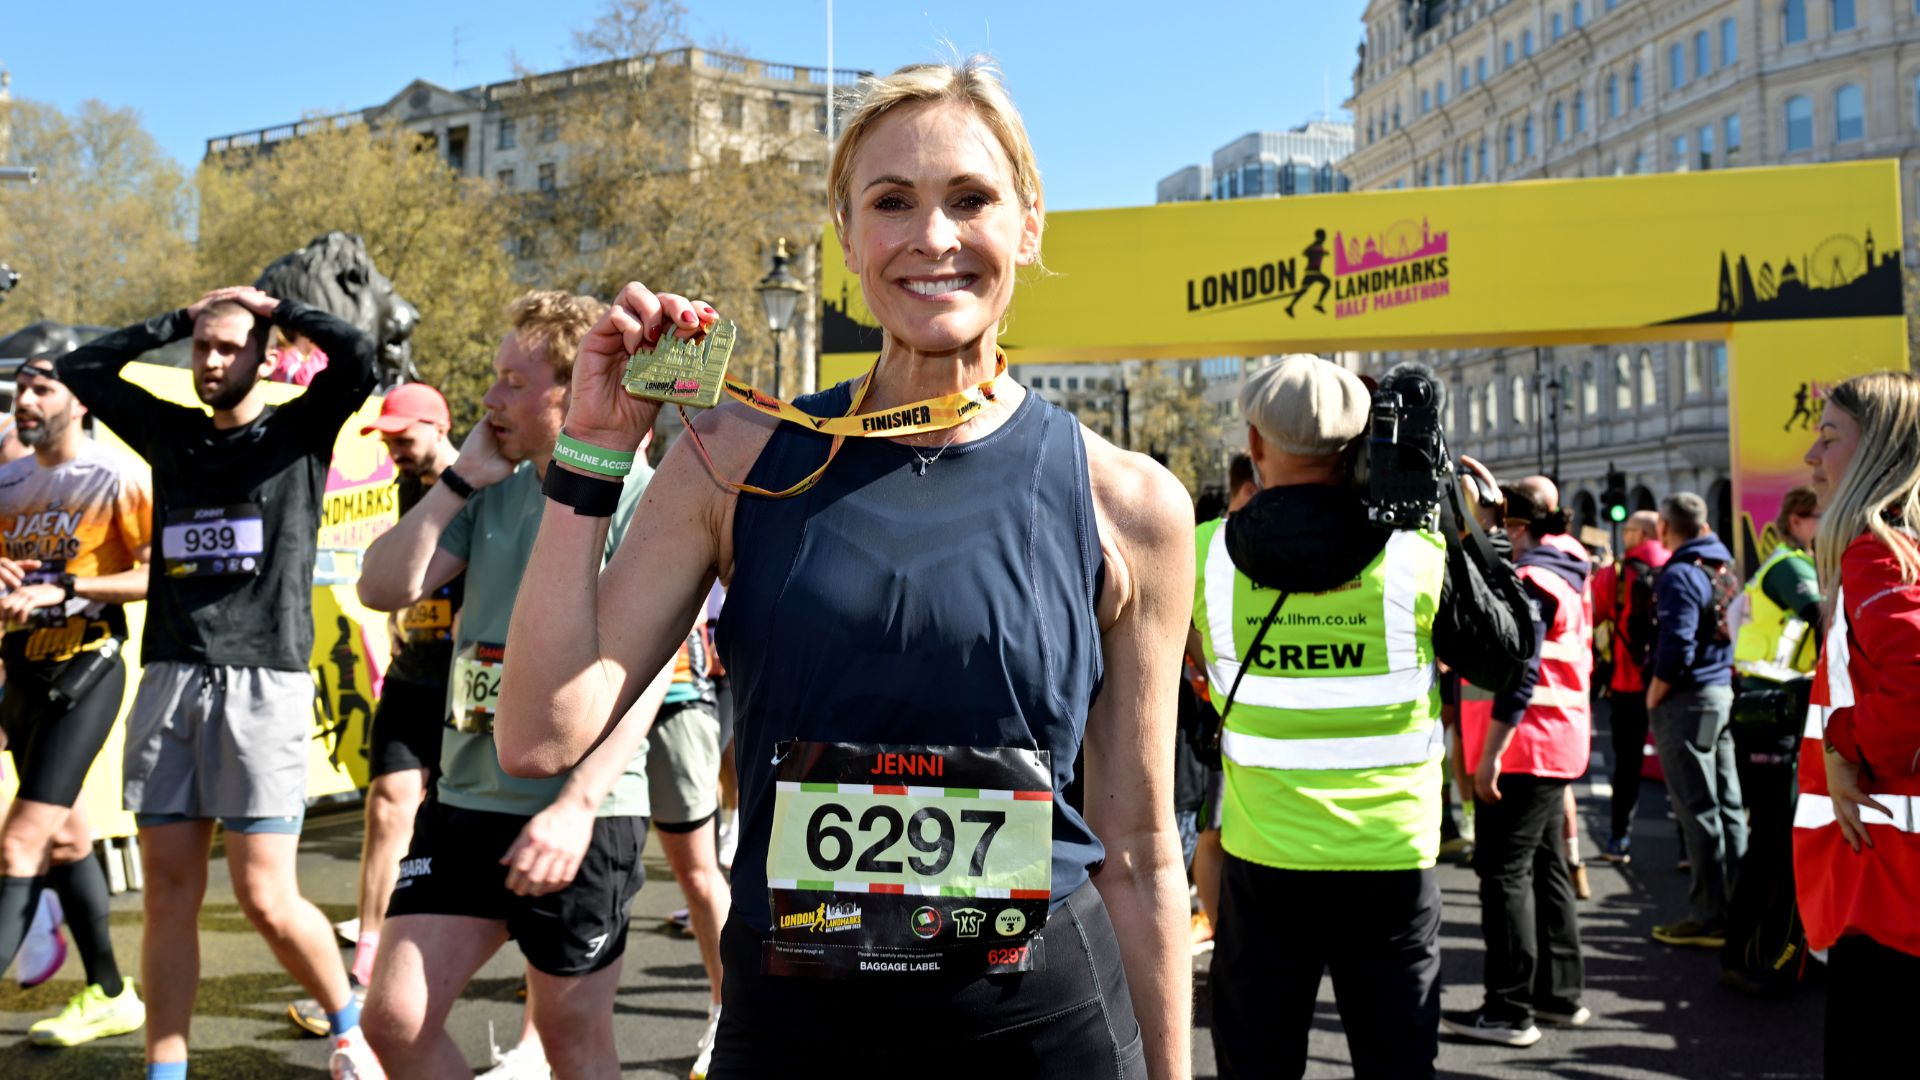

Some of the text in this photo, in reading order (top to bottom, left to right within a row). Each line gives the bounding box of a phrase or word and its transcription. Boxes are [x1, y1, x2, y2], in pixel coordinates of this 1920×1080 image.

[1187, 257, 1296, 312] LONDON
[1335, 256, 1449, 301] LANDMARKS
[1335, 279, 1450, 320] HALF MARATHON
[645, 382, 670, 391] LONDON
[862, 405, 931, 431] FINISHER
[184, 526, 235, 552] 939
[1254, 643, 1365, 670] CREW
[871, 752, 944, 777] JENNI
[806, 803, 1006, 877] 6297
[781, 911, 816, 929] LONDON
[826, 915, 861, 928] LANDMARKS
[960, 915, 977, 933] XS
[1005, 923, 1015, 932] 3
[860, 961, 941, 972] BAGGAGE LABEL
[988, 947, 1029, 965] 6297
